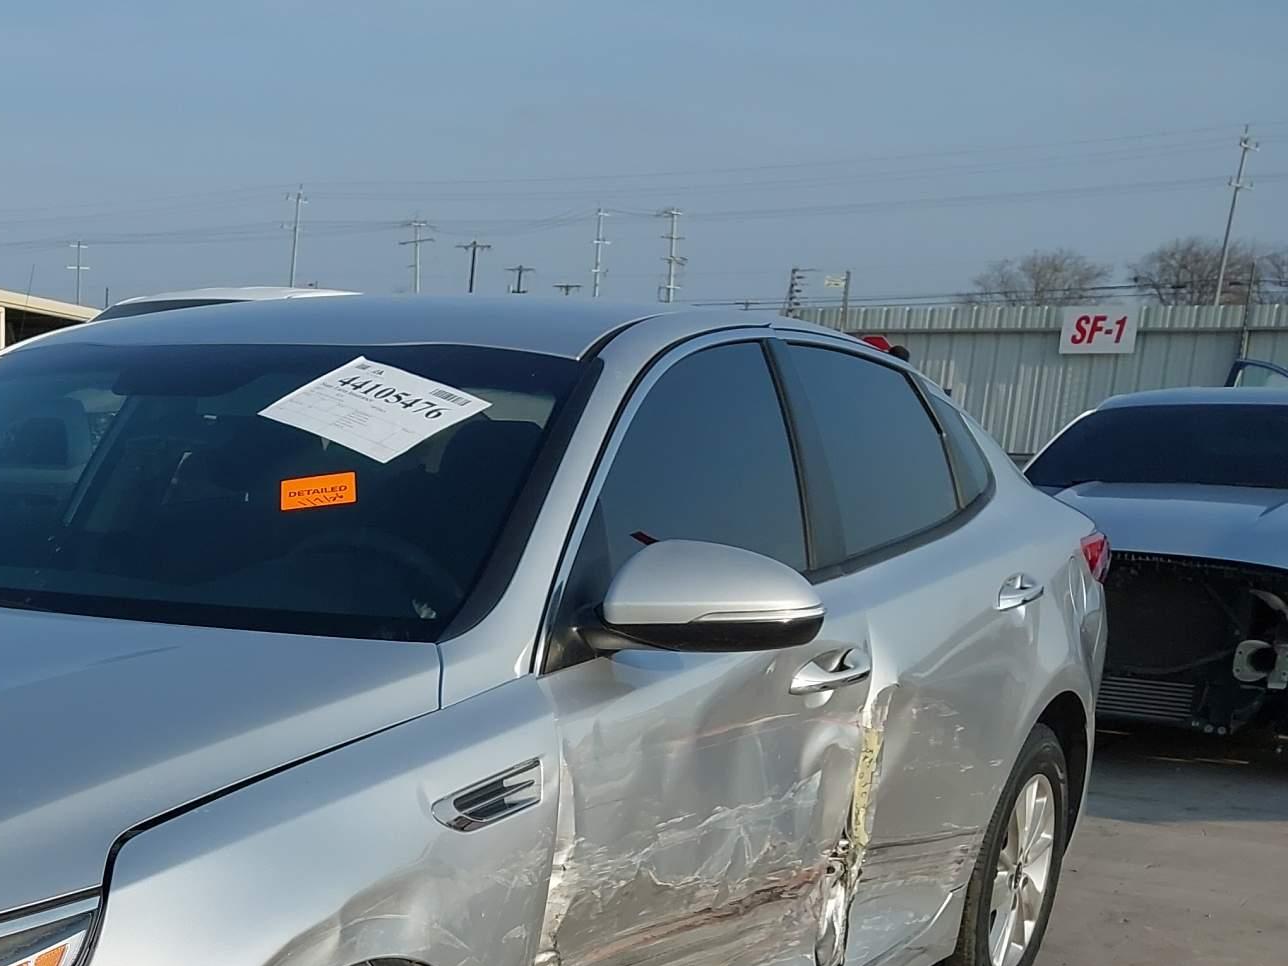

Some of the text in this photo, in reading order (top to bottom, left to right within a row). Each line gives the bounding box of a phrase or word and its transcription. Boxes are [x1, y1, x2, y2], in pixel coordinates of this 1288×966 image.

[1070, 314, 1128, 345] SF-1
[338, 375, 453, 420] 44105476
[288, 484, 348, 498] DETAILED
